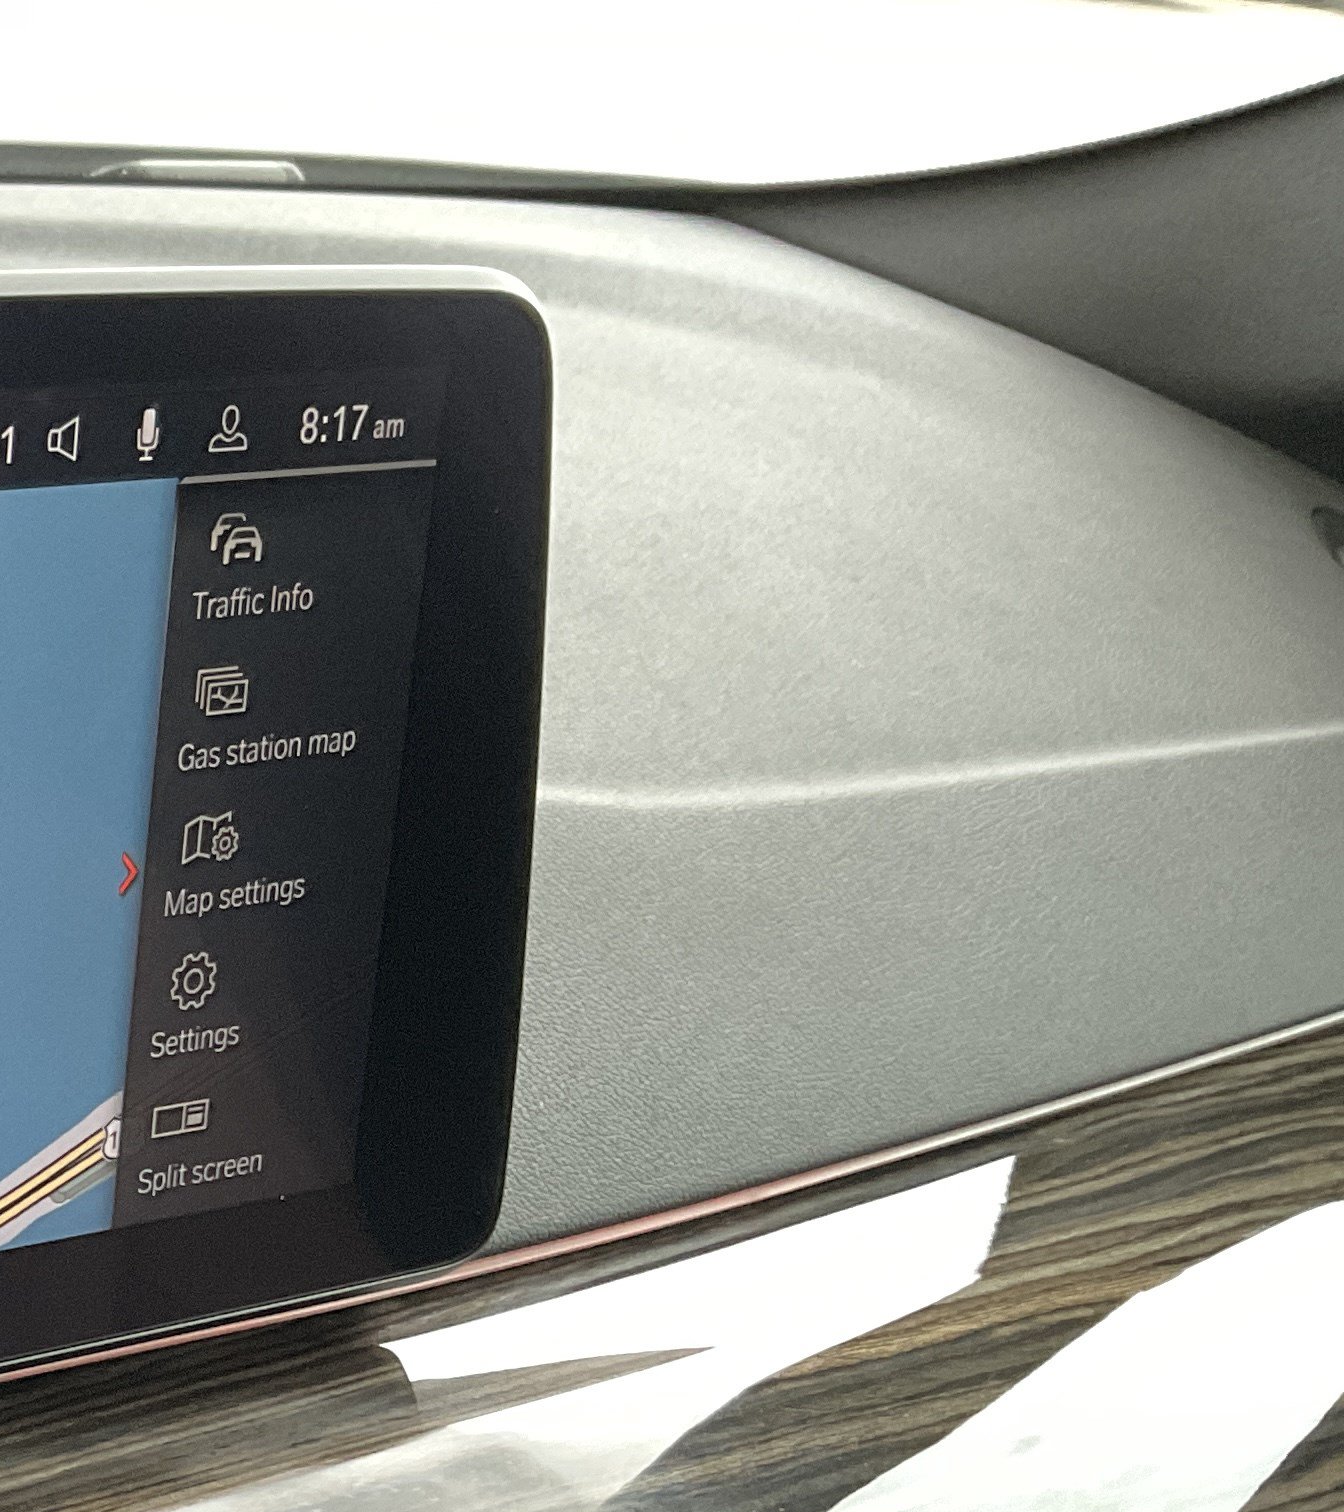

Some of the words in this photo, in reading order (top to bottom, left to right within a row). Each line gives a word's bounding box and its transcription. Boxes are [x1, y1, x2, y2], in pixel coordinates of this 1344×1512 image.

[300, 404, 369, 444] 8:17
[372, 418, 405, 439] am
[192, 587, 264, 619] Traffic
[270, 582, 313, 612] Info
[178, 744, 220, 772] Gas
[226, 735, 301, 766] station
[308, 727, 357, 758] map
[163, 889, 213, 917] Map
[217, 875, 306, 909] settings
[150, 1022, 240, 1058] Settings
[110, 1131, 118, 1149] 1
[137, 1163, 186, 1197] Split
[192, 1153, 263, 1184] screen
